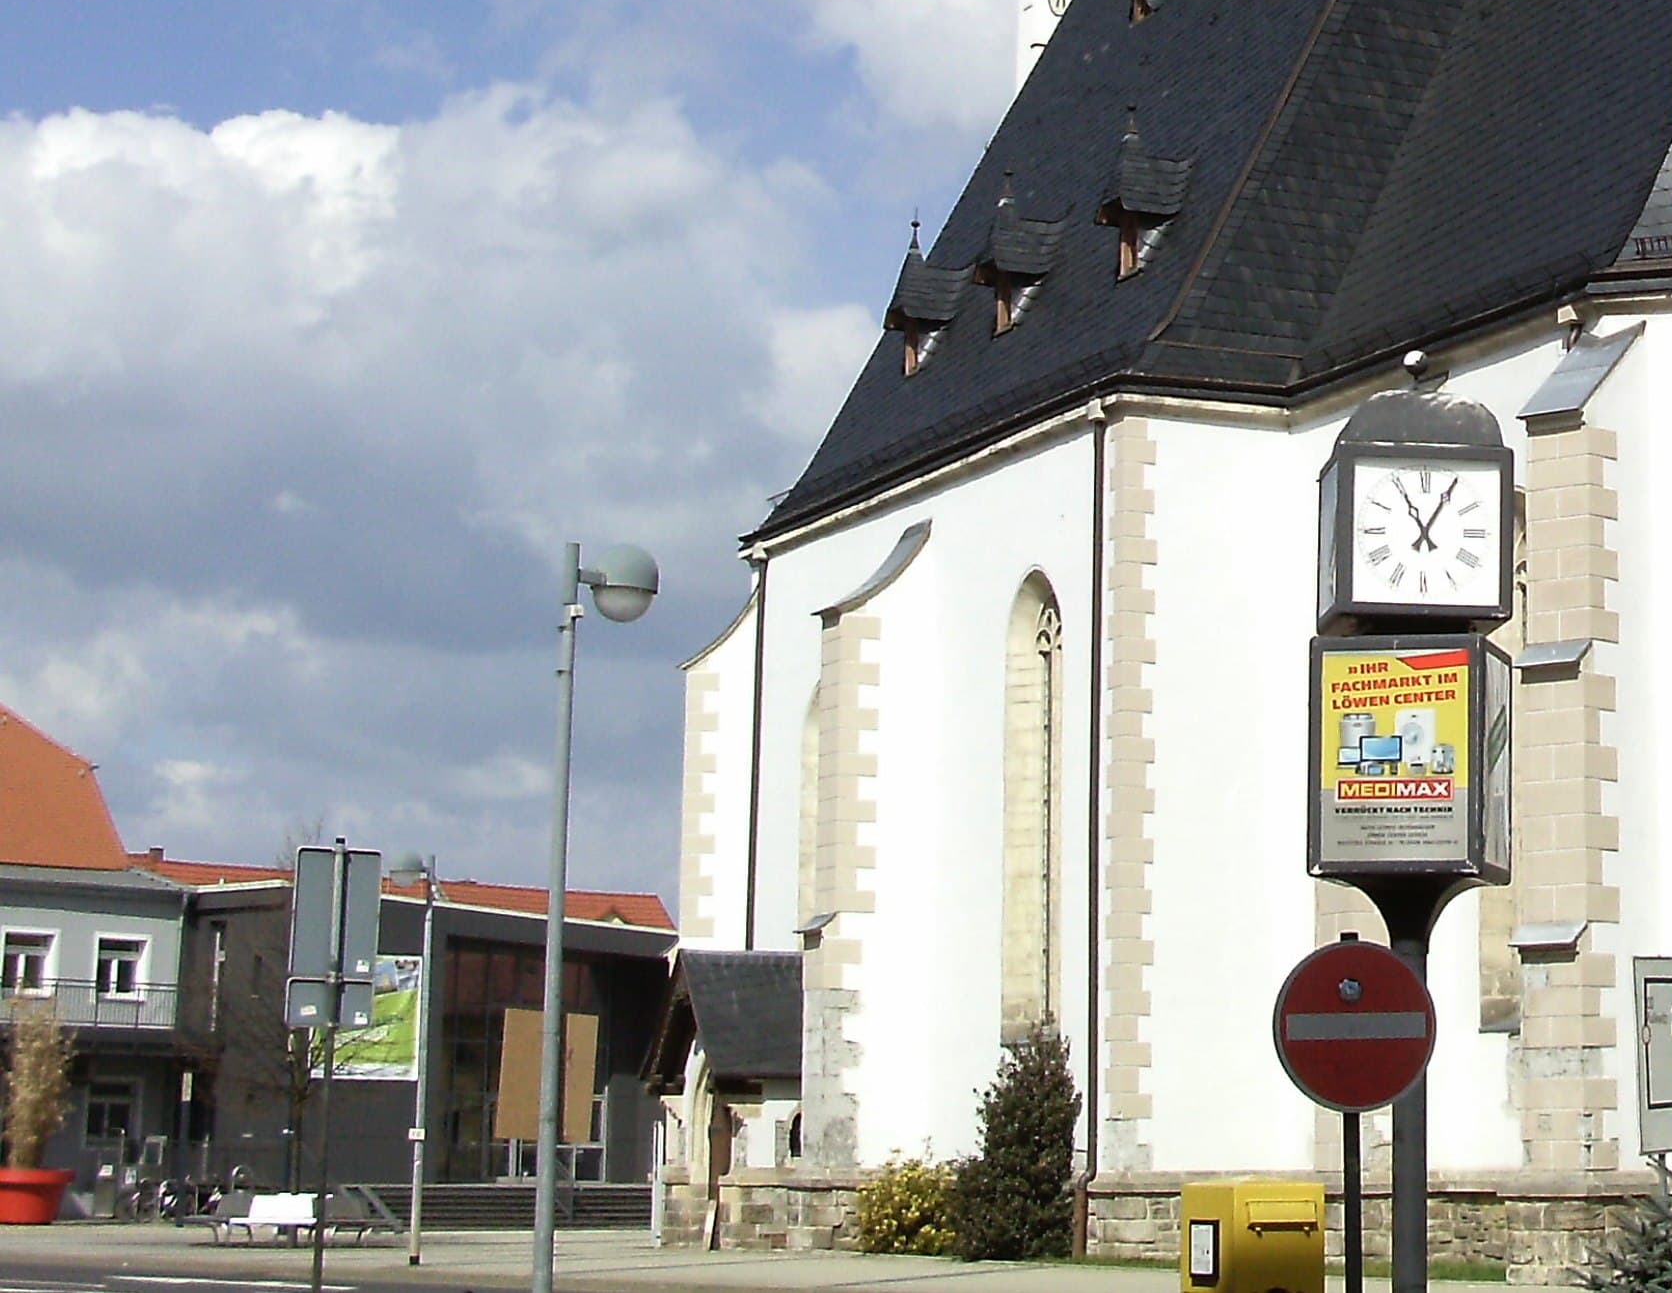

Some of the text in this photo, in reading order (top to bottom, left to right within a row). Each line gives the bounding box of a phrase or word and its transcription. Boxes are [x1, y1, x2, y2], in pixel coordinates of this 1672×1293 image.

[1360, 662, 1388, 674] IHR
[1331, 673, 1458, 693] FACHMARKT IM
[1332, 690, 1456, 709] LÖWEN CENTER
[1340, 781, 1449, 797] MEDIMAX
